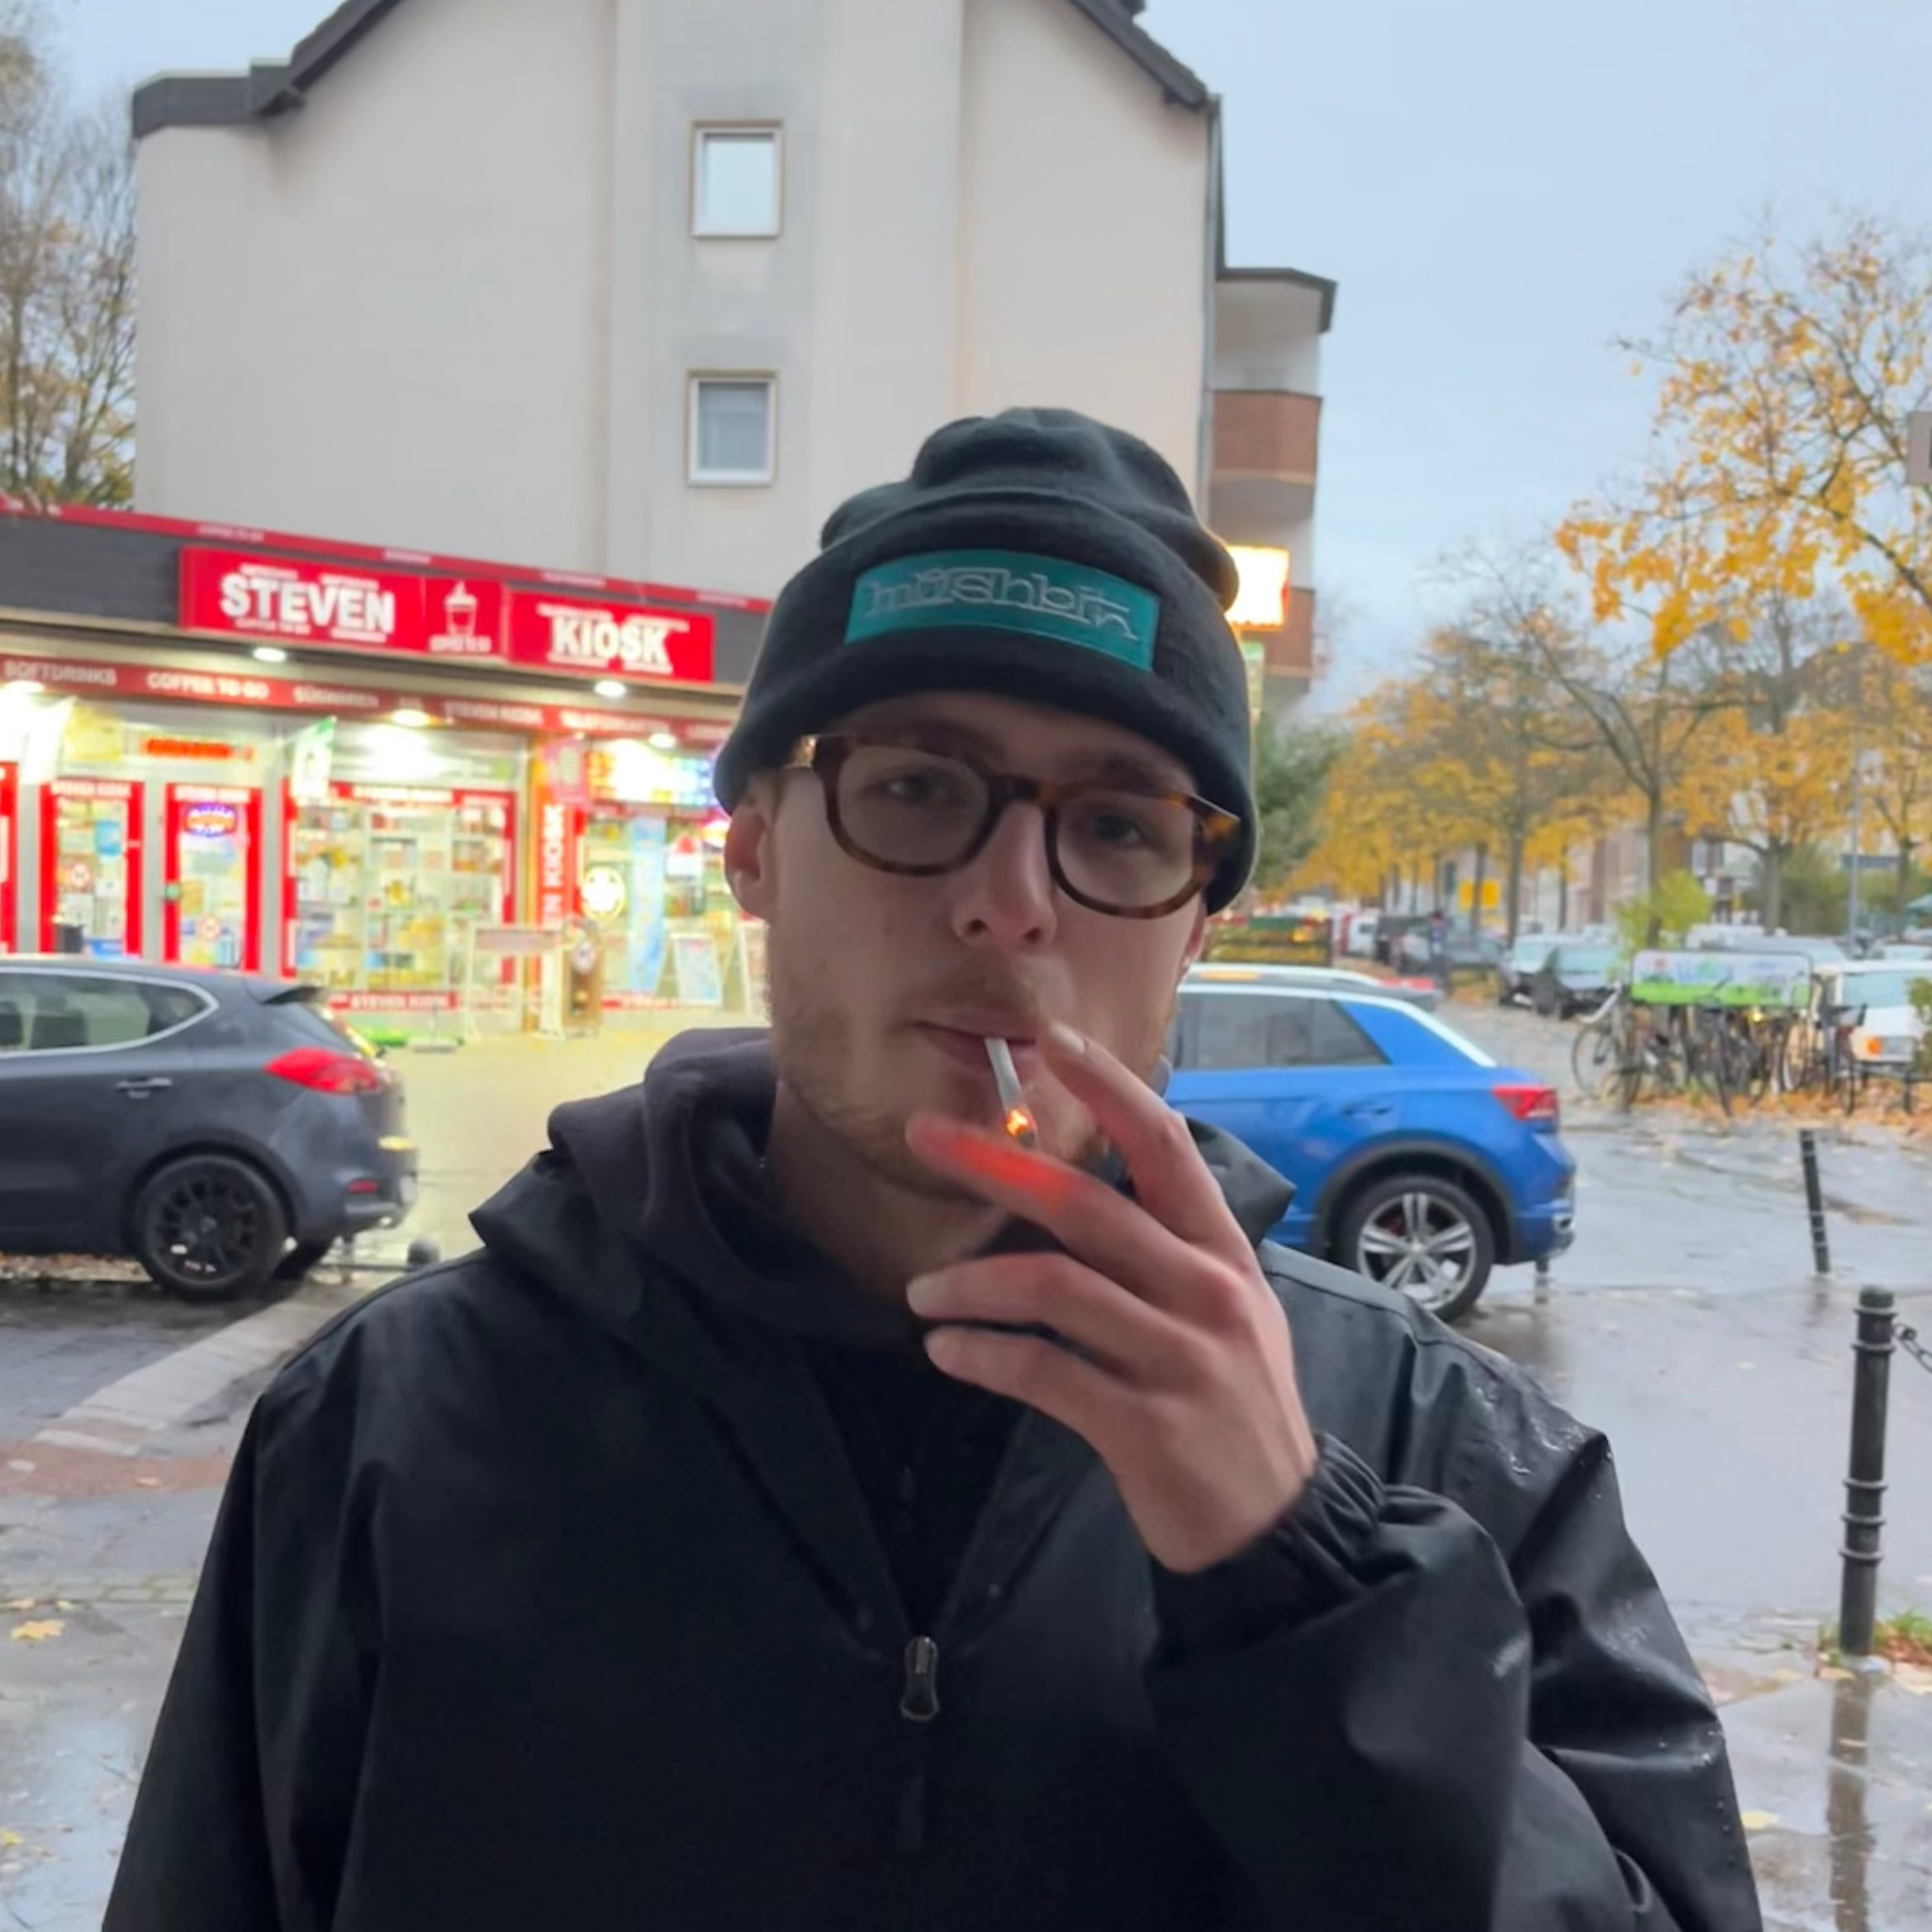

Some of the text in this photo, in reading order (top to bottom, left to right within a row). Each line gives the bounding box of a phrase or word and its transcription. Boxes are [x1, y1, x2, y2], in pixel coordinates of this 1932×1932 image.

[220, 572, 395, 634] STEVEN
[552, 612, 672, 667] KIOSK
[146, 671, 270, 700] COFFEE TO GO
